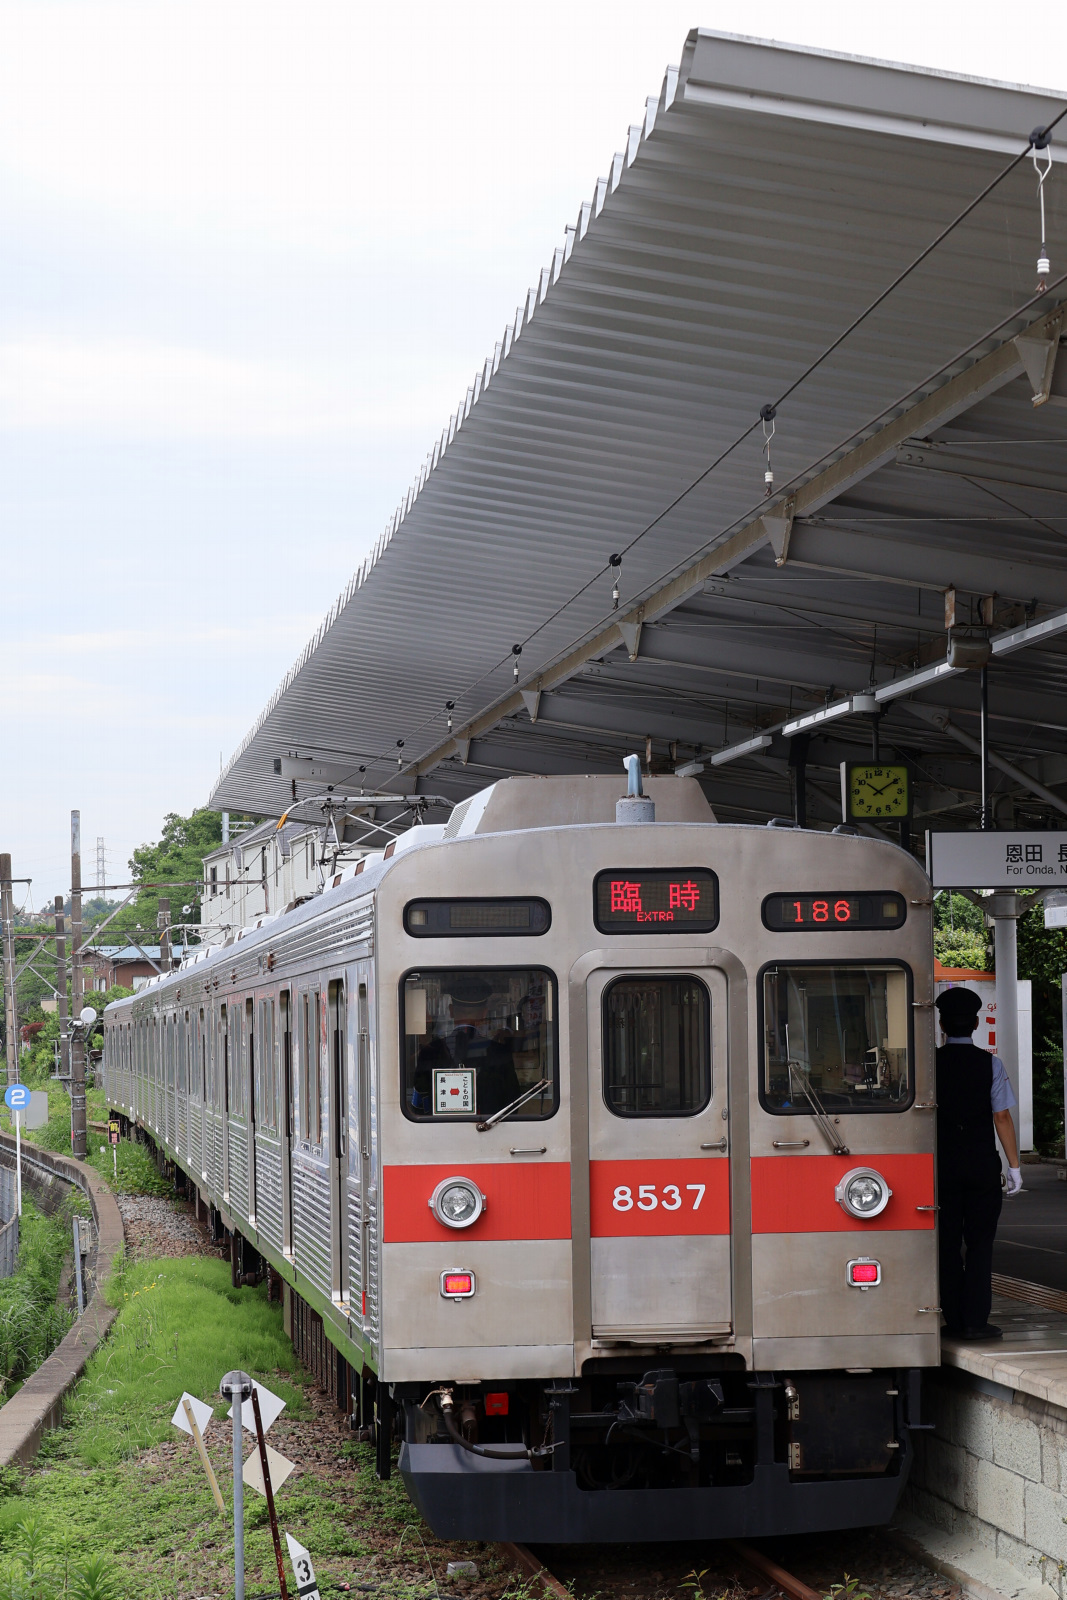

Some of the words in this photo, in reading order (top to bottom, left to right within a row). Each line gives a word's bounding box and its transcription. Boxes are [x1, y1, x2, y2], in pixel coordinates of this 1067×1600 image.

[1006, 844, 1042, 862] 恩田
[1006, 866, 1023, 874] For
[1026, 865, 1056, 875] Onda,
[610, 880, 700, 912] 臨時
[636, 911, 674, 922] EXTRA
[793, 900, 851, 923] 186
[11, 1089, 26, 1104] 2
[612, 1184, 706, 1211] 8537
[297, 1560, 311, 1582] 3
